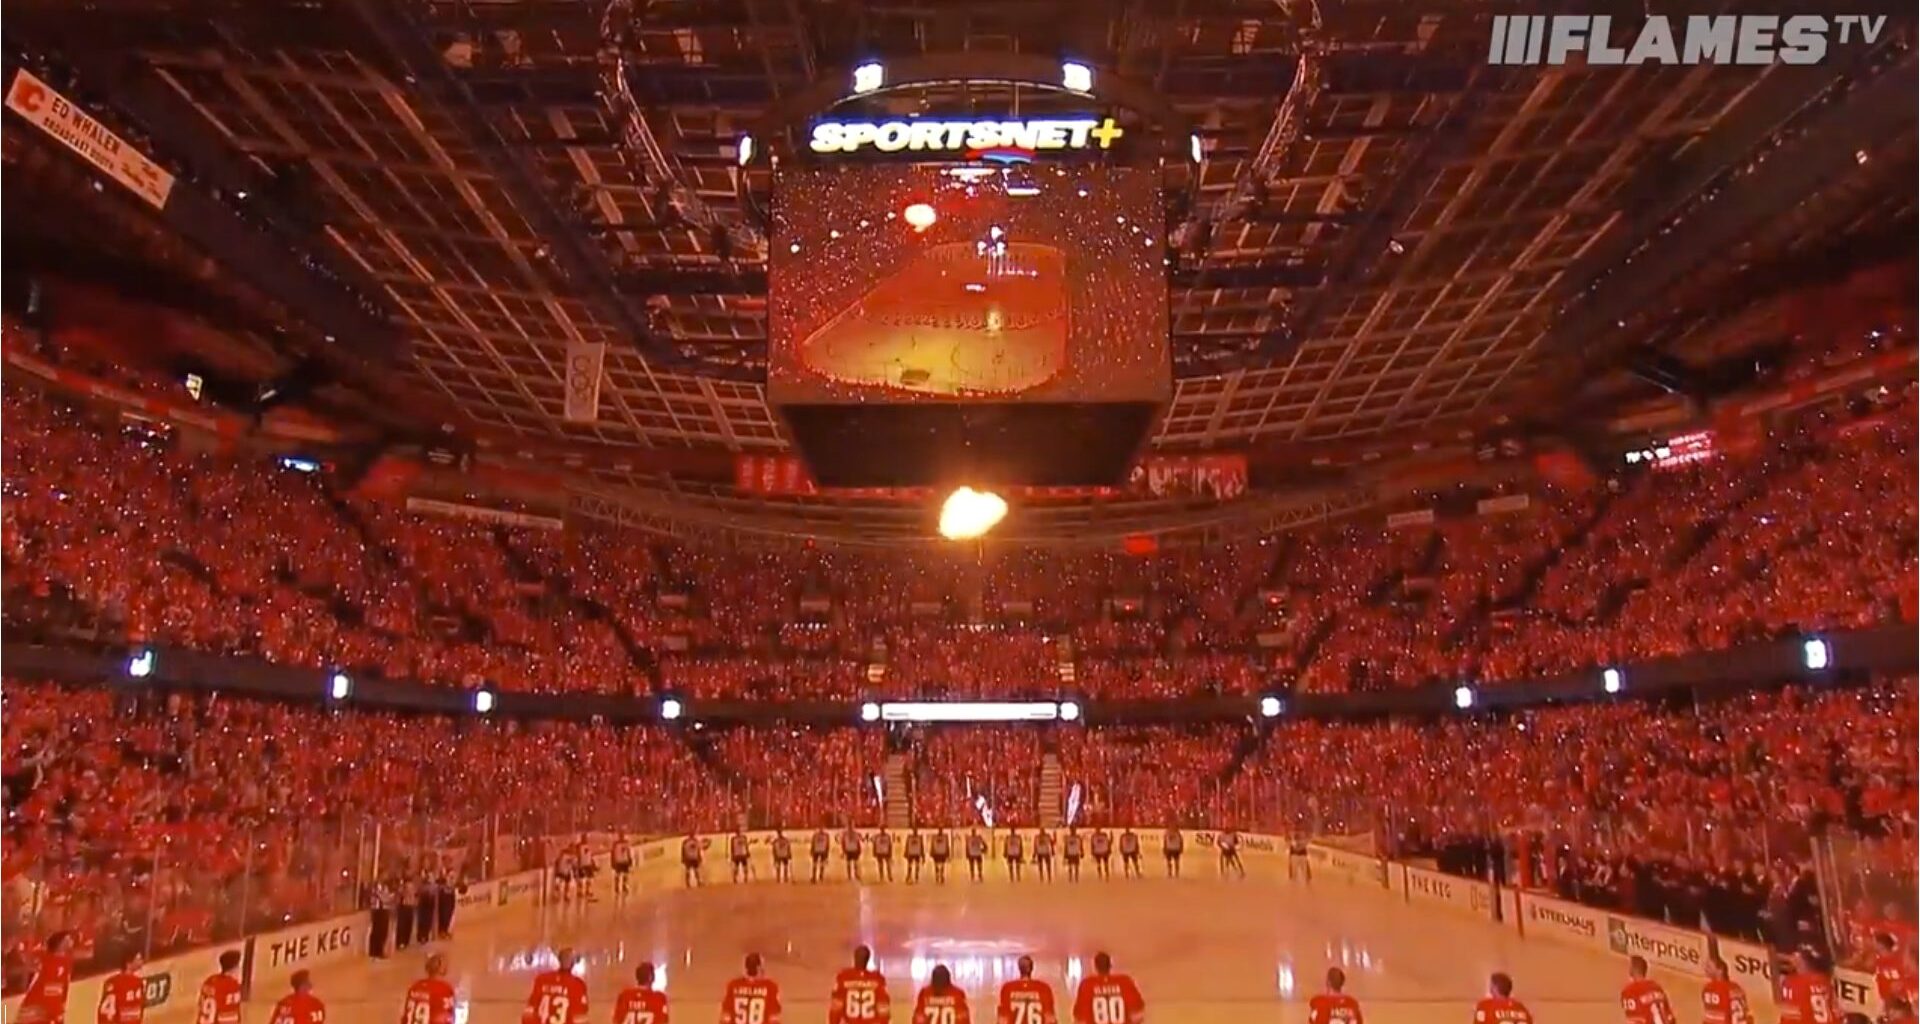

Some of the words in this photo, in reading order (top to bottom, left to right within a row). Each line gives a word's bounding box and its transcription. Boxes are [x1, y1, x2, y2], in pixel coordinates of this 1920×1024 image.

[51, 97, 70, 119] ED
[72, 113, 121, 155] WHALEN
[271, 936, 309, 967] THE
[317, 926, 350, 955] KEG
[538, 994, 570, 1024] 43
[734, 997, 766, 1024] 58
[846, 989, 876, 1019] 62
[923, 1006, 956, 1024] 70
[1010, 1001, 1042, 1024] 76
[1092, 996, 1125, 1024] 80
